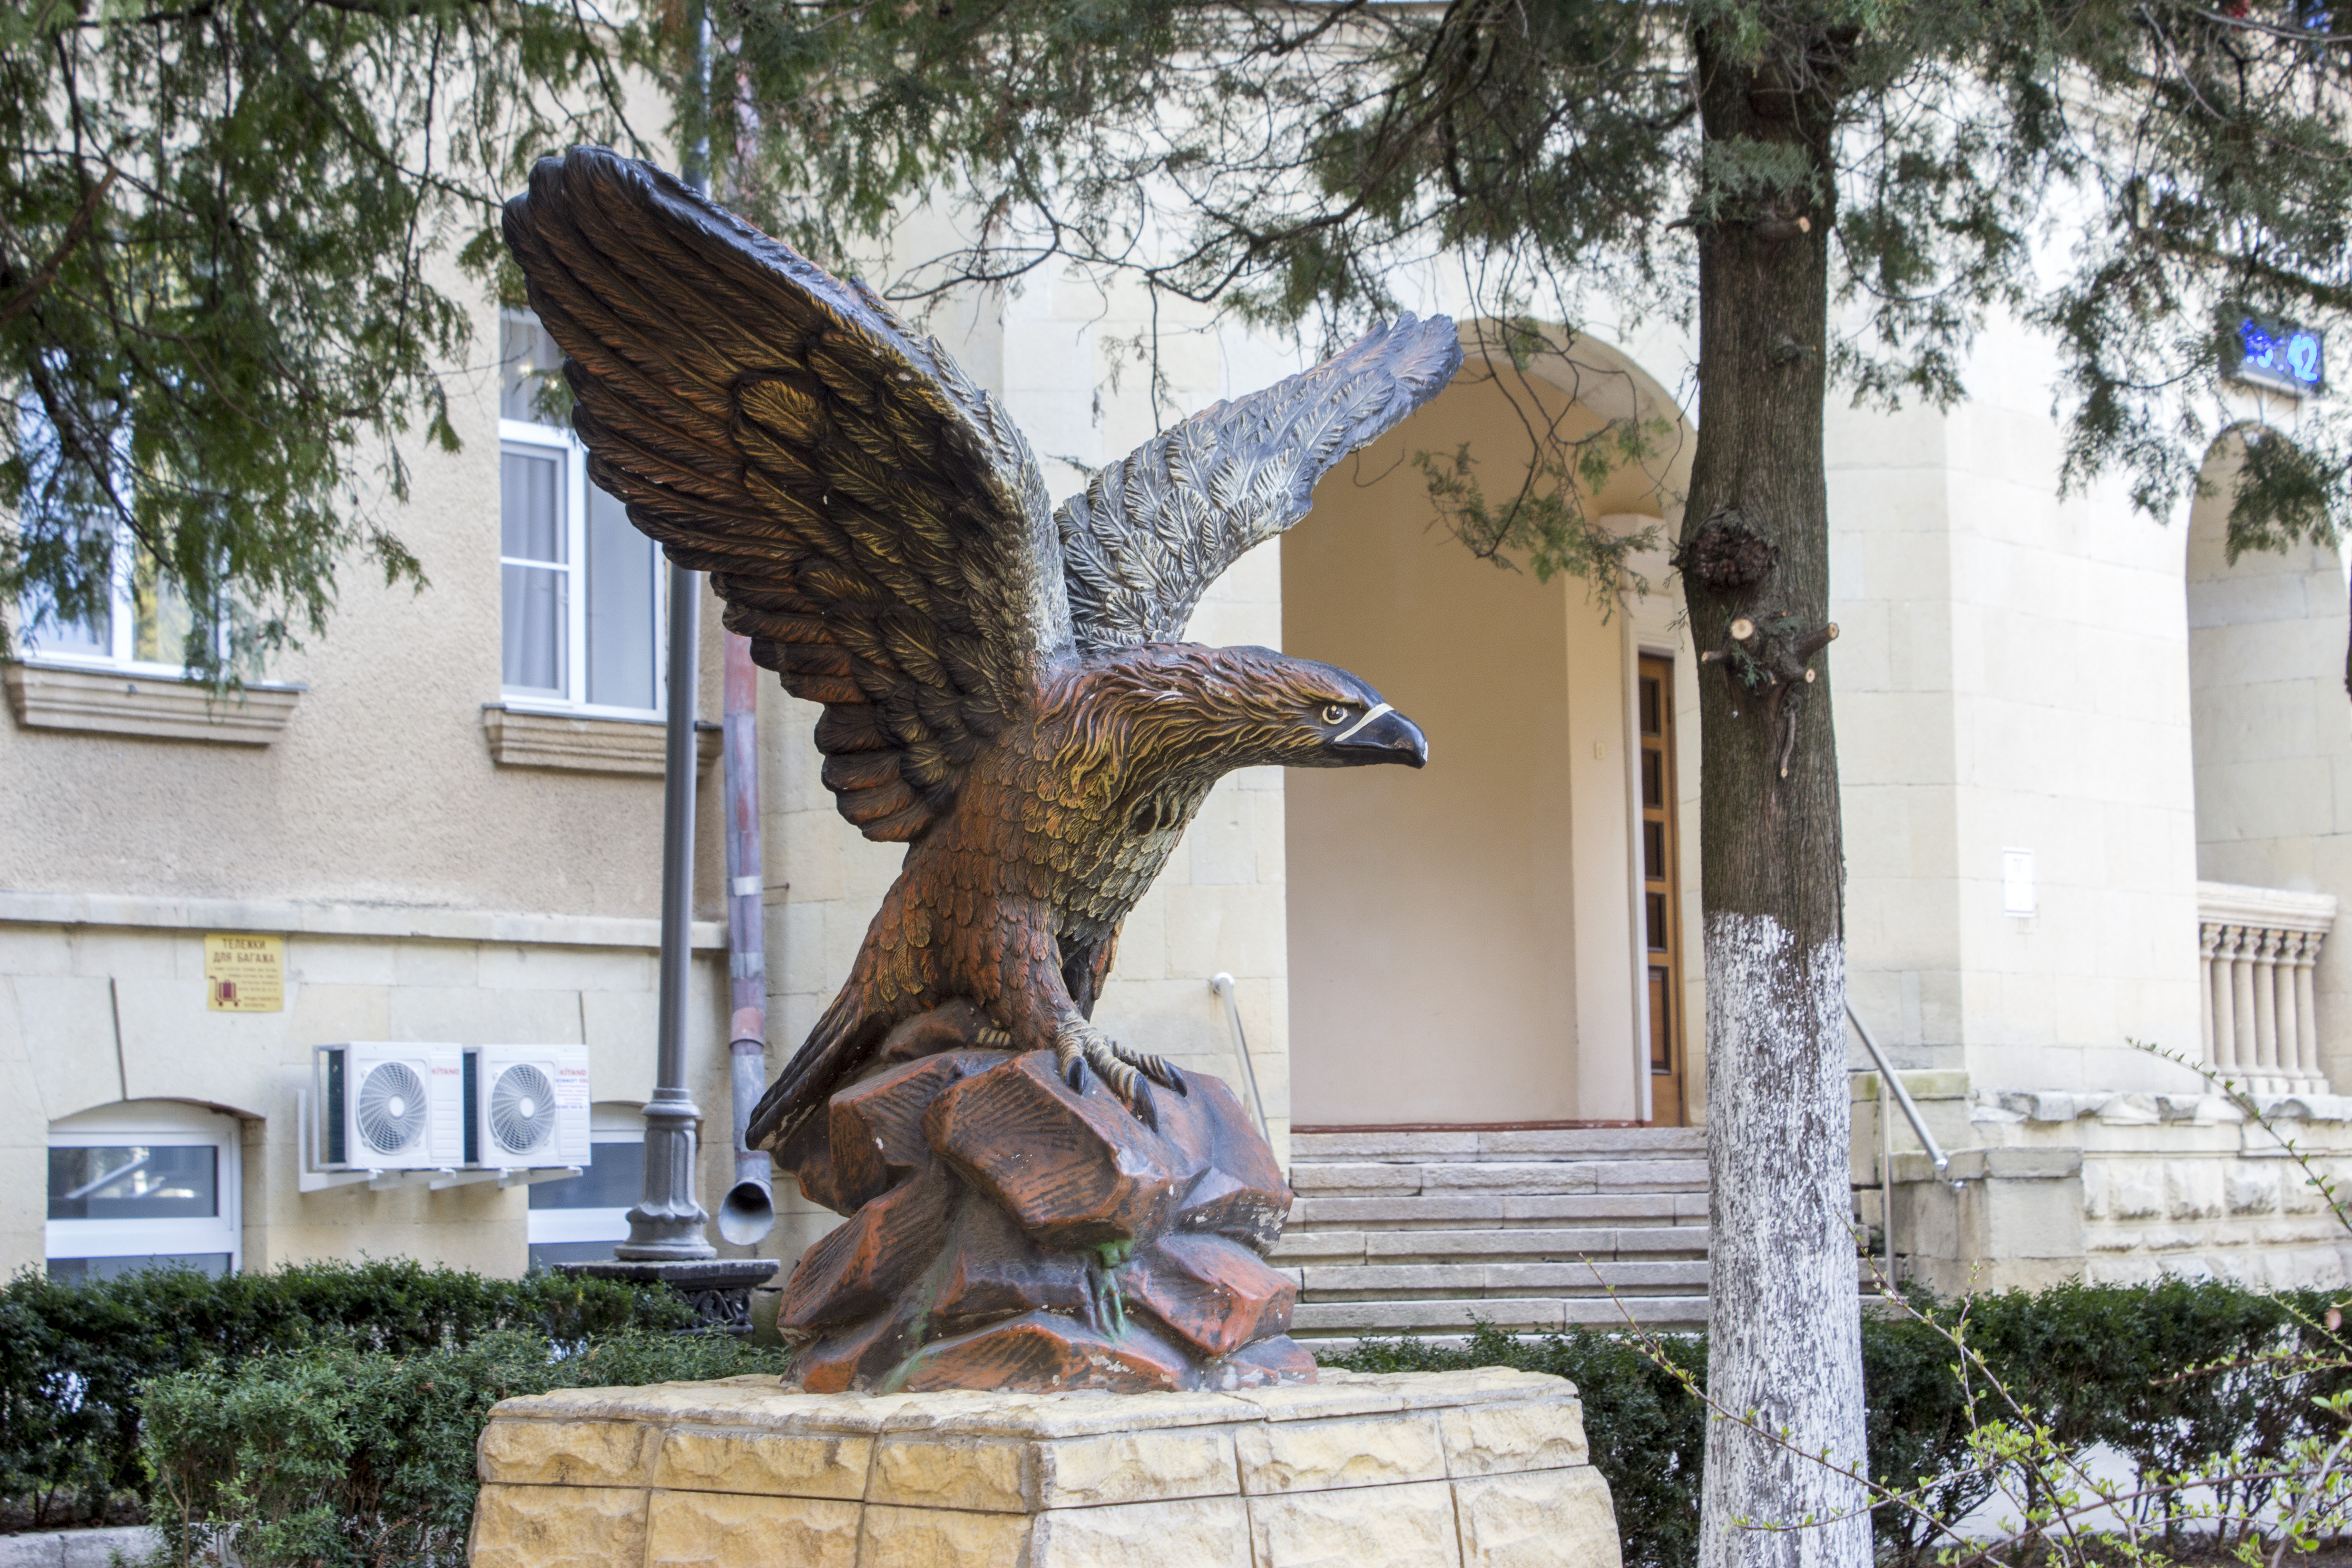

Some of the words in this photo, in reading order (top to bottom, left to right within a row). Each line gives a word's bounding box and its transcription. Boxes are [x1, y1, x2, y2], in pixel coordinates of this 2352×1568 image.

[223, 938, 265, 949] ТЕЛЕЖКИ
[214, 952, 232, 963] ДЛЯ
[237, 952, 275, 963] БАГАЖА
